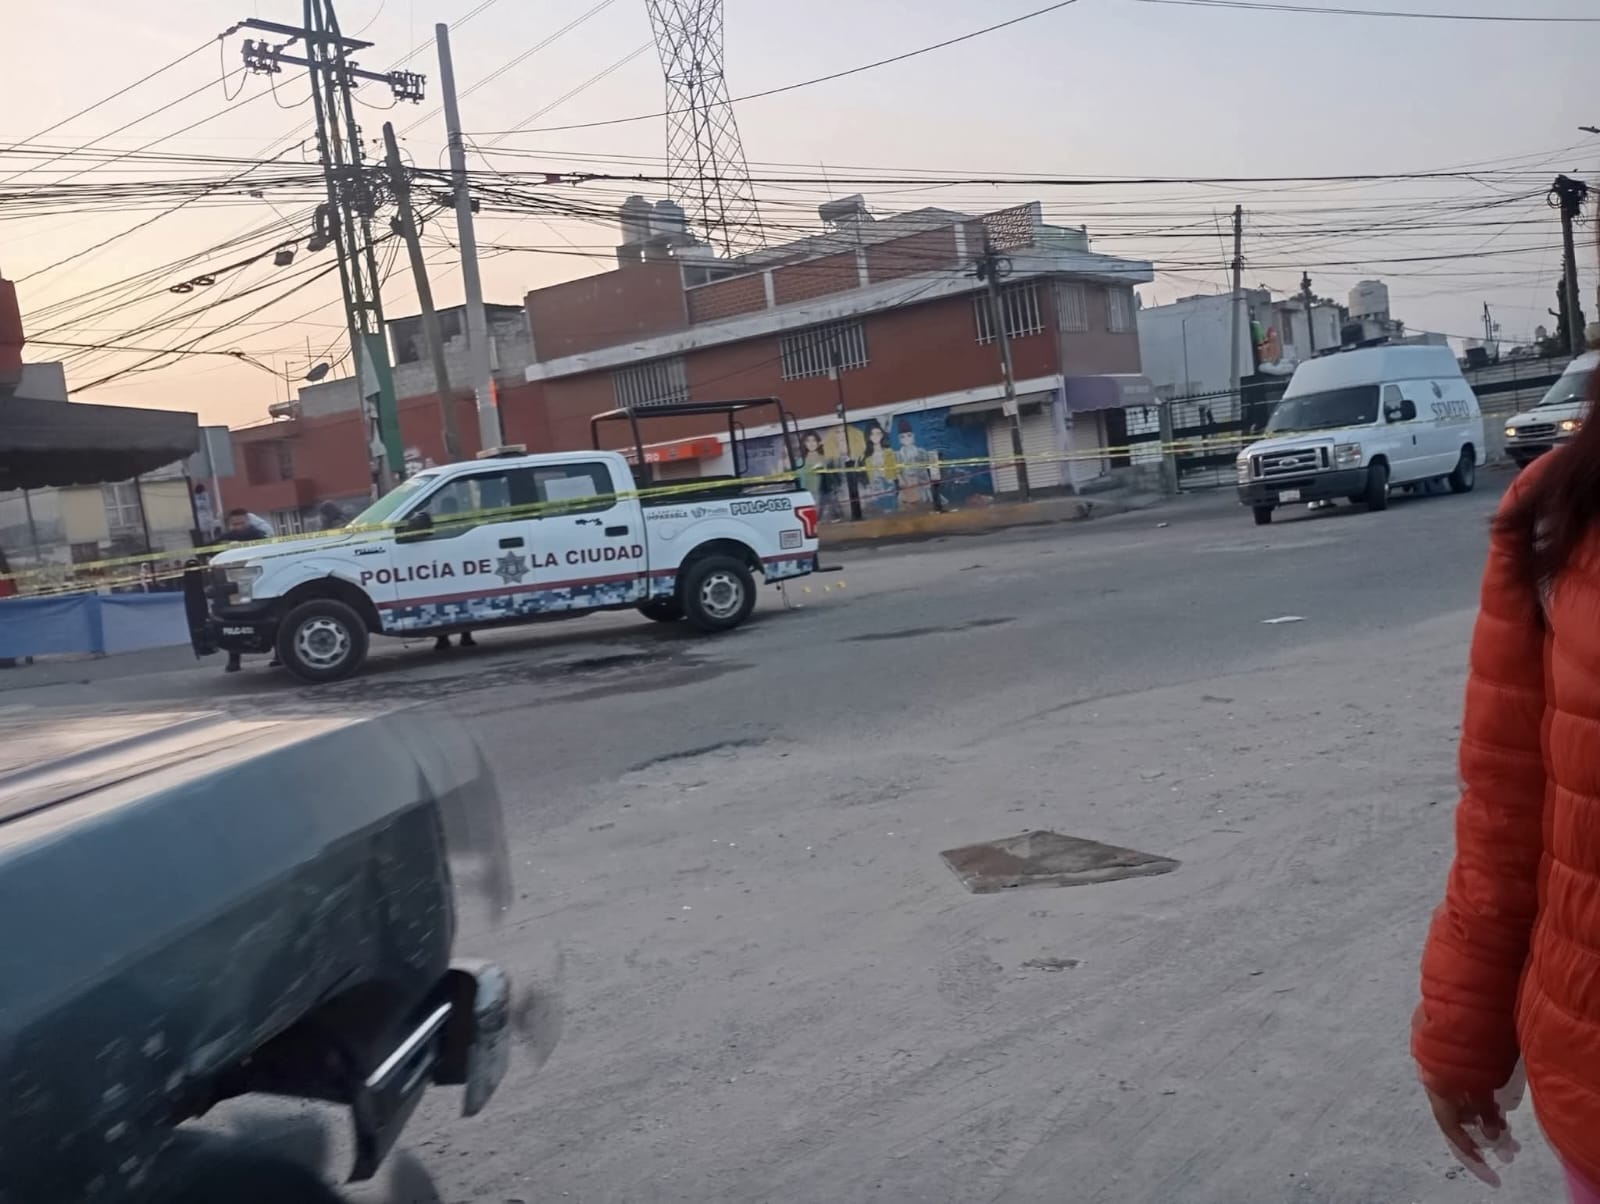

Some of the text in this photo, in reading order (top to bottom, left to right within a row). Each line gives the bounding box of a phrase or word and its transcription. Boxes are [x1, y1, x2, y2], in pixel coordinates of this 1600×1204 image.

[730, 498, 792, 516] PDLC-032
[360, 544, 643, 586] POLICÍA DE LA CIUDAD
